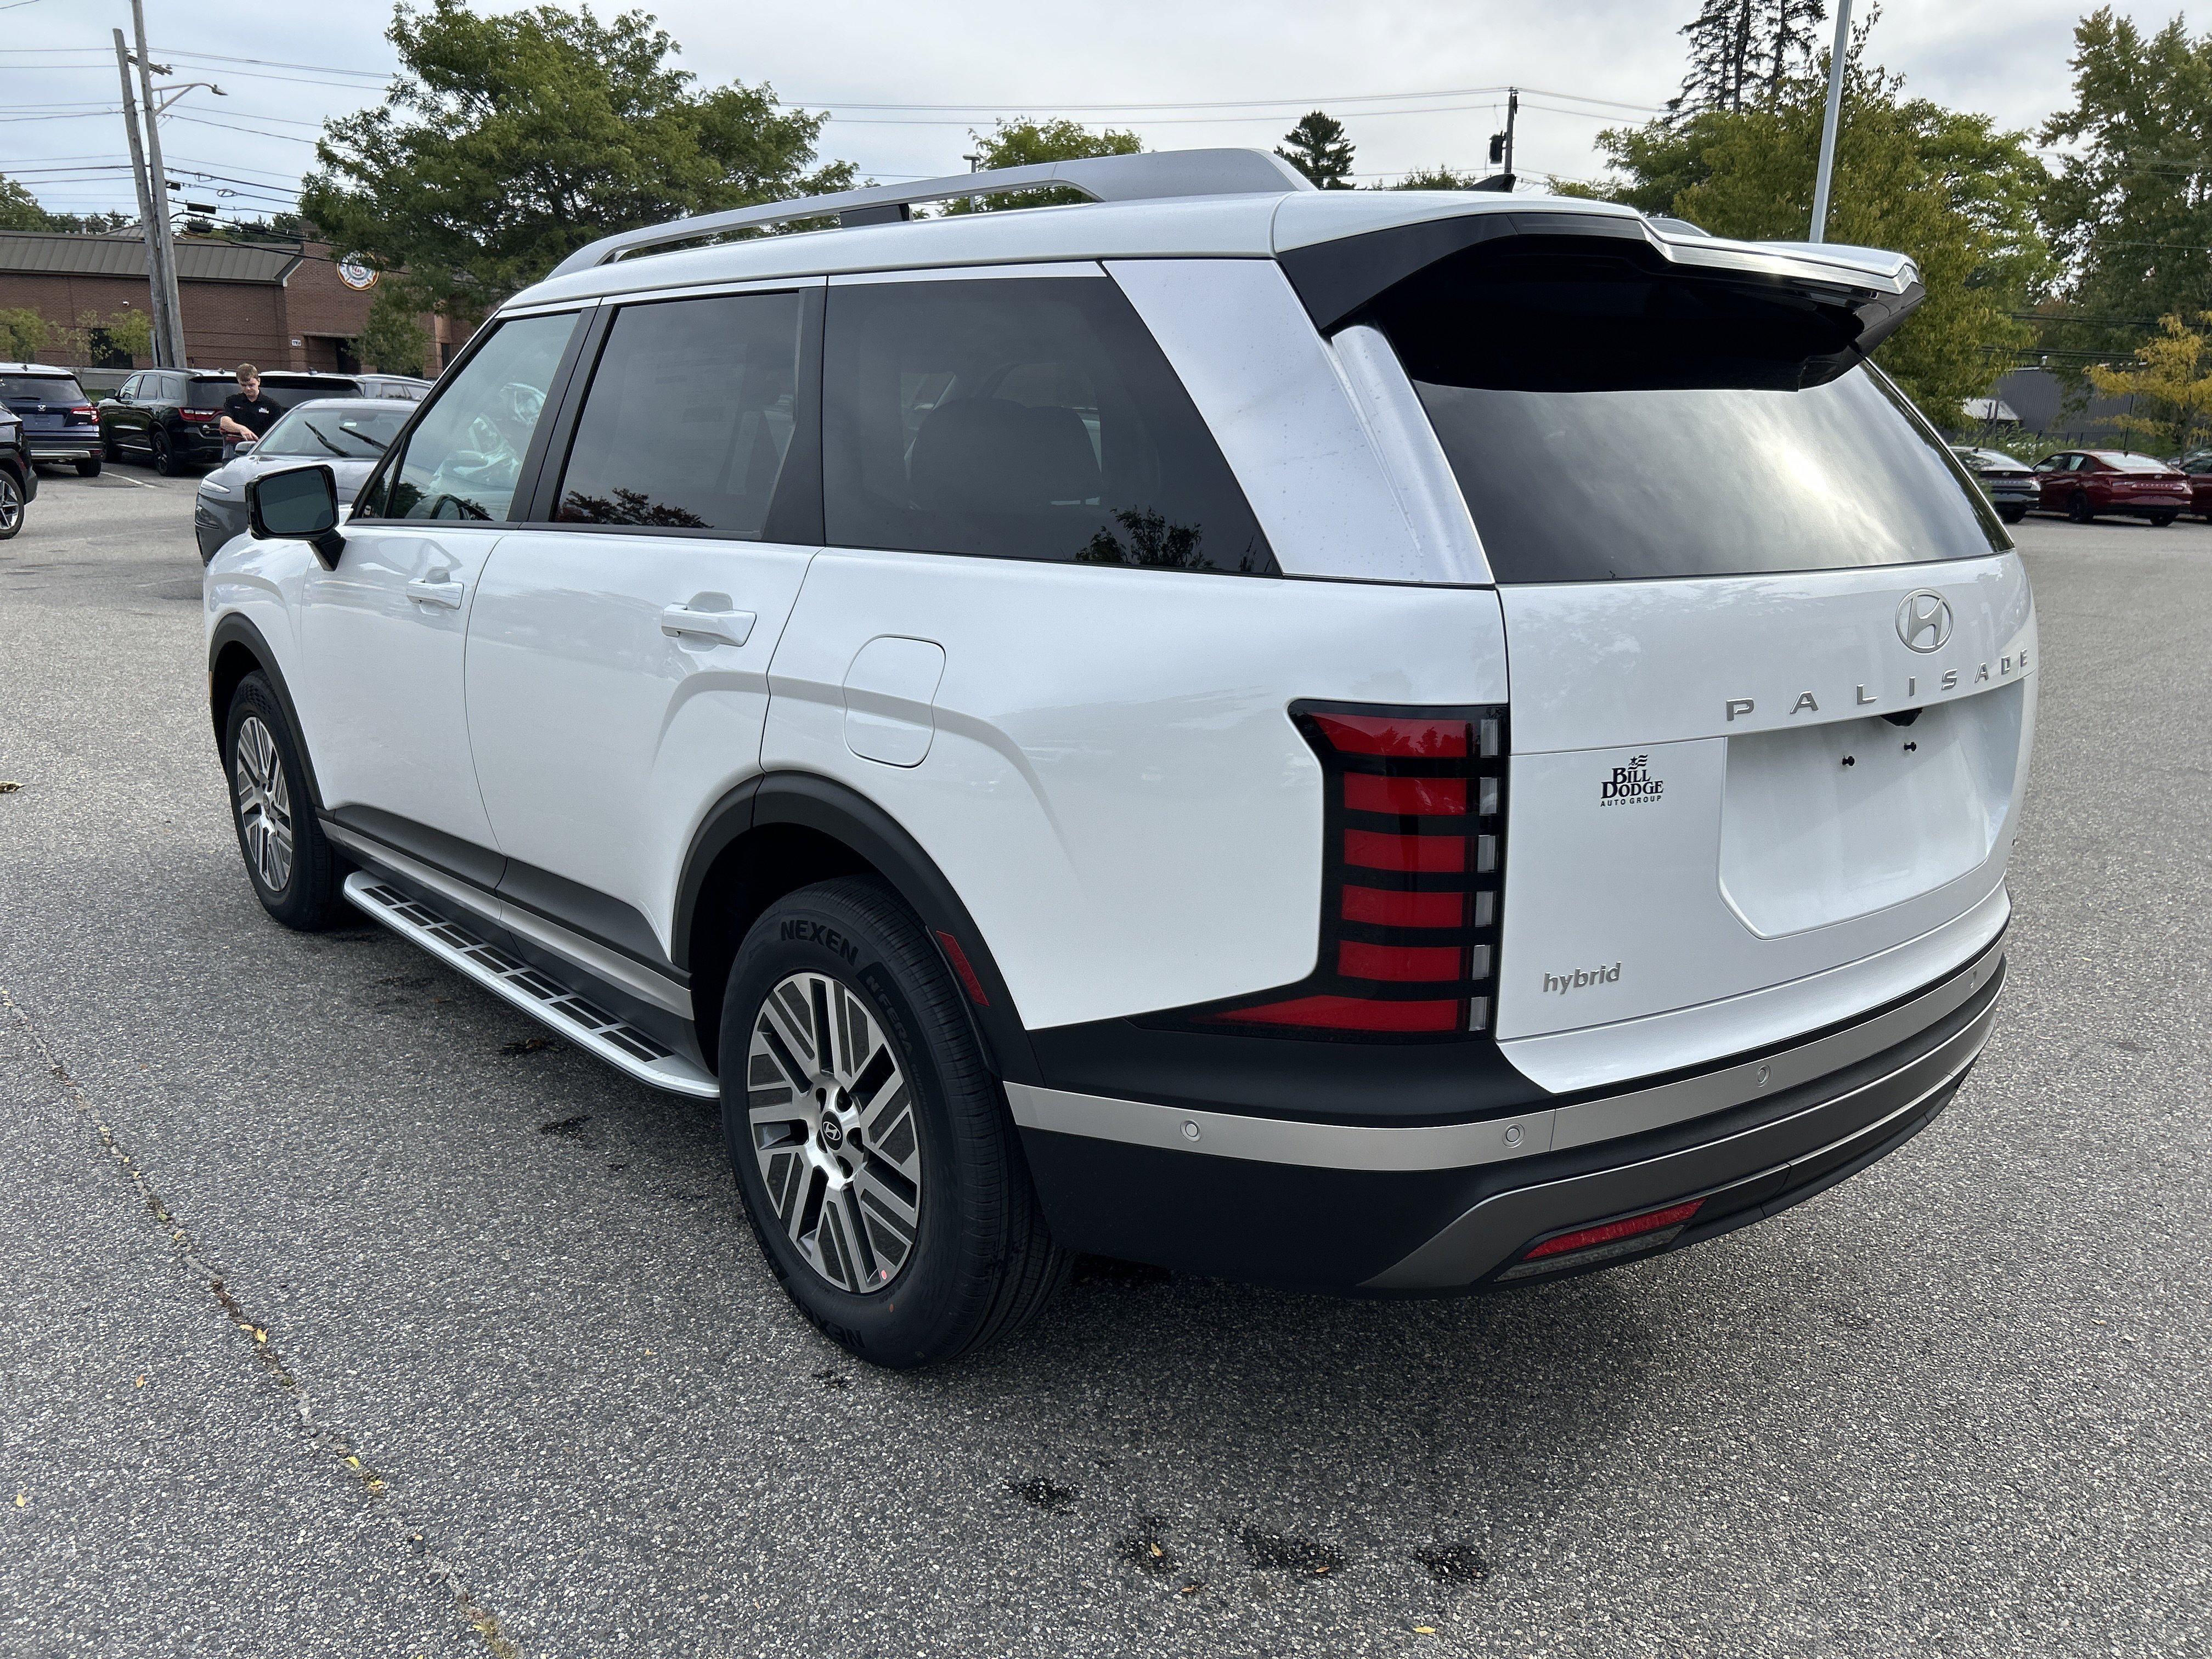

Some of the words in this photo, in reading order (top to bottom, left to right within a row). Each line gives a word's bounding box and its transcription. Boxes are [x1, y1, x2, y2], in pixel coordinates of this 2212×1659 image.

[1726, 648, 2029, 721] PALISADE
[1612, 768, 1651, 784] BILL
[1601, 781, 1663, 798] DODGE
[1629, 795, 1662, 804] GROUP
[781, 919, 859, 966] NEXEN
[1542, 961, 1622, 995] hybrid
